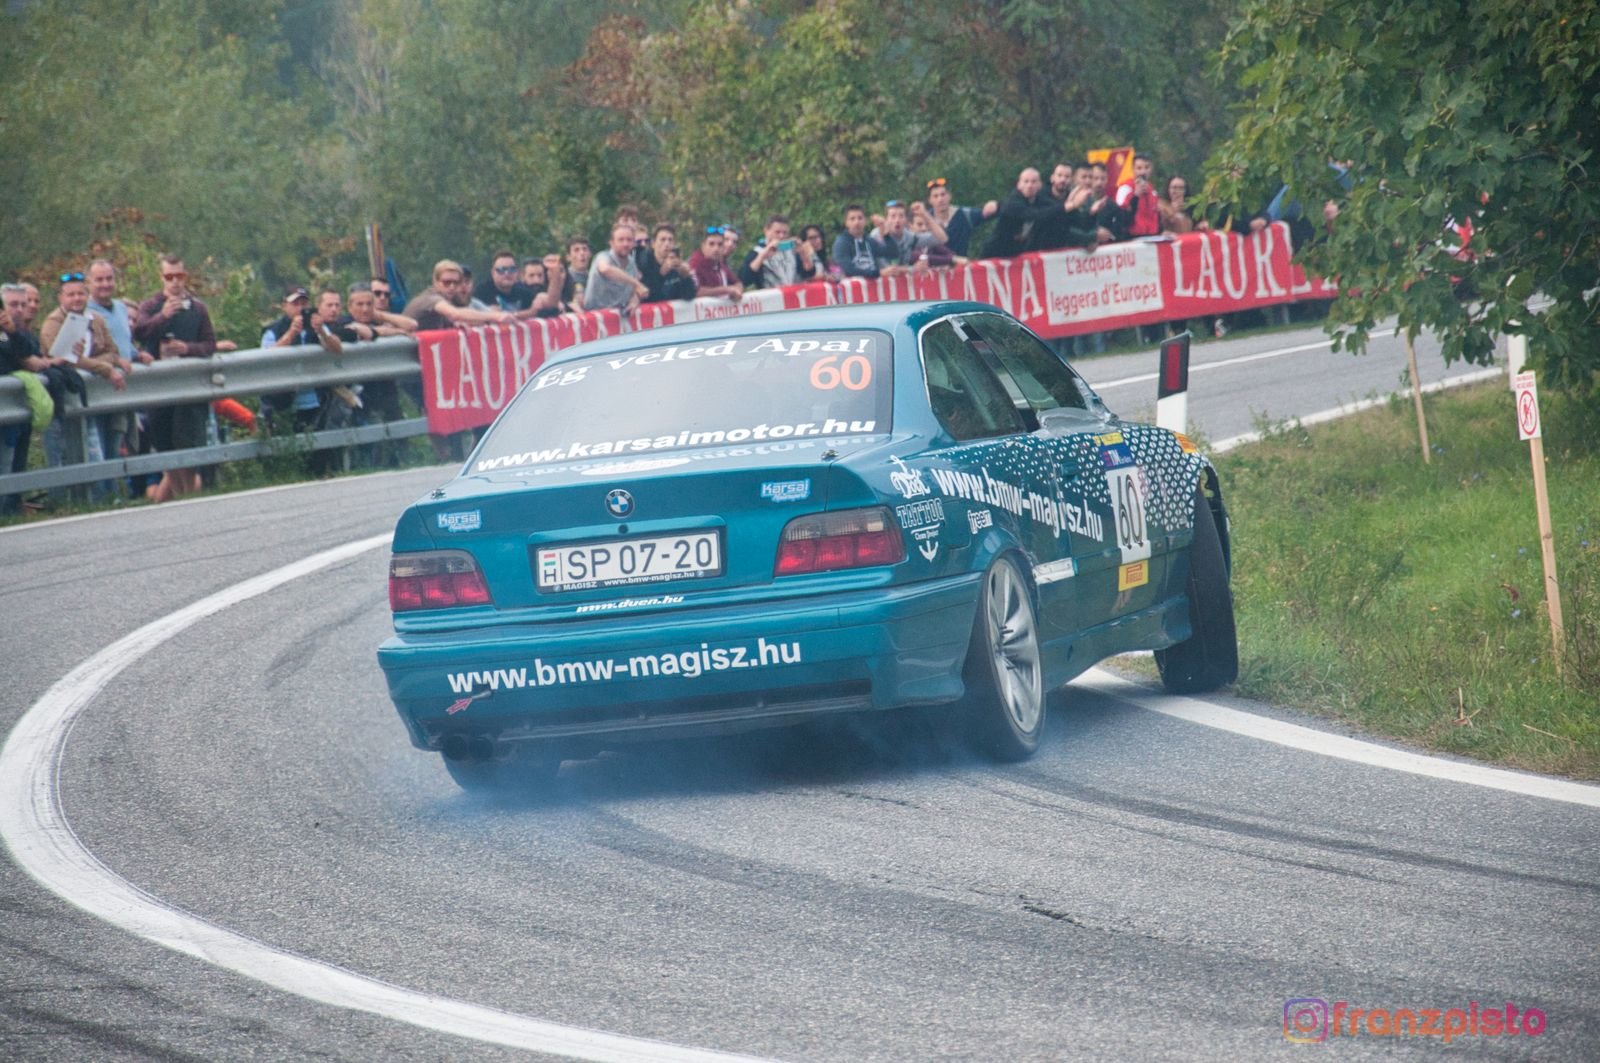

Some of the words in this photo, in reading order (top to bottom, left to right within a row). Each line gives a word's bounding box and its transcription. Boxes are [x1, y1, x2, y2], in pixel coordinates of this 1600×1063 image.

[1066, 253, 1113, 277] L'acqua
[1116, 250, 1137, 271] più
[1051, 289, 1099, 316] leggera
[1102, 284, 1159, 306] d'Europa
[532, 366, 592, 391] Ég
[608, 340, 737, 370] veled
[748, 338, 871, 357] Apa!
[810, 355, 872, 391] 60
[478, 418, 876, 472] www.karsaimotor.hu
[896, 498, 945, 529] TATTOO
[930, 466, 1104, 542] www.bmw-magisz.hu
[1117, 474, 1144, 550] 60
[544, 569, 557, 584] H
[568, 548, 611, 580] SP
[619, 538, 713, 575] 07-20
[563, 581, 598, 591] MAGISZ
[604, 571, 695, 586] www.bmw-magisz.hu
[447, 637, 802, 694] www.bmw-magisz.hu
